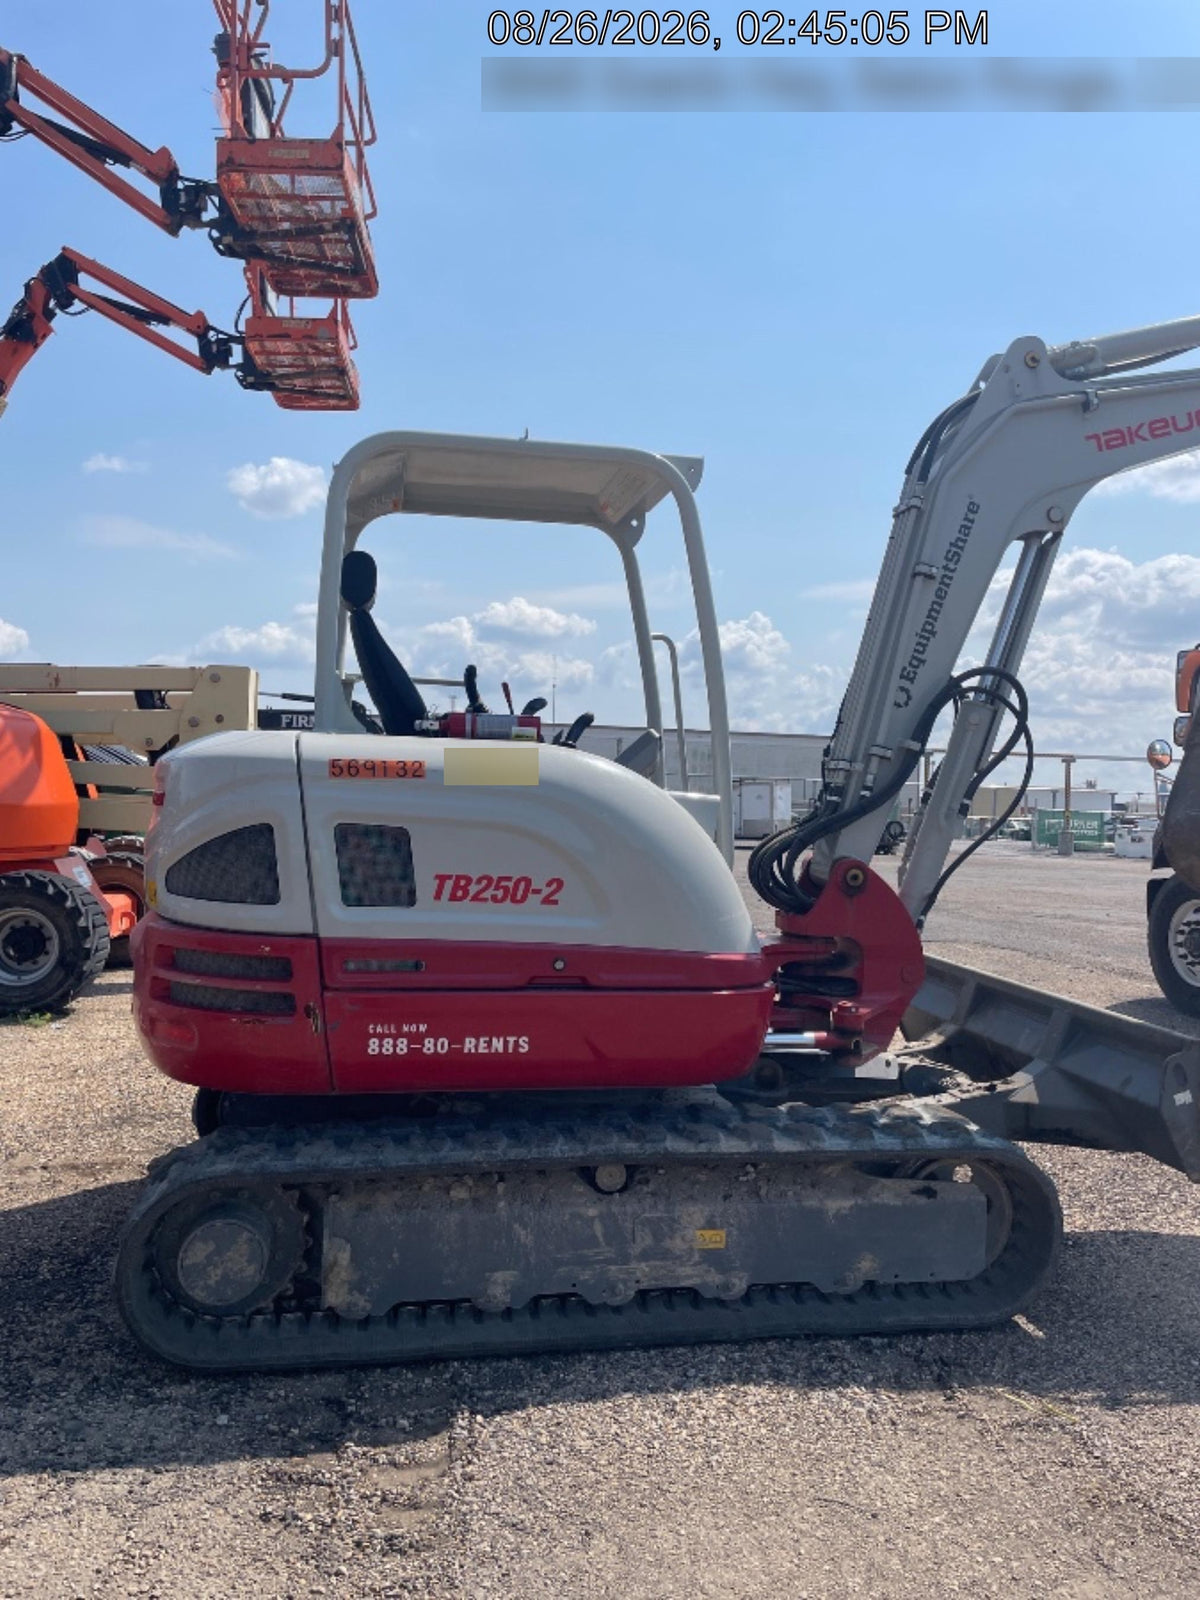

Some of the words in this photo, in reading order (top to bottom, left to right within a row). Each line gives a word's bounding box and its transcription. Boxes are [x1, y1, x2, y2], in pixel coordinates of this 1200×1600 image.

[899, 500, 980, 686] EquipmentShare
[330, 758, 425, 778] 569132
[433, 874, 565, 906] TB250-2
[368, 1023, 397, 1034] CALL
[402, 1023, 428, 1034] NOW
[367, 1036, 530, 1056] 888-80-RENTS
